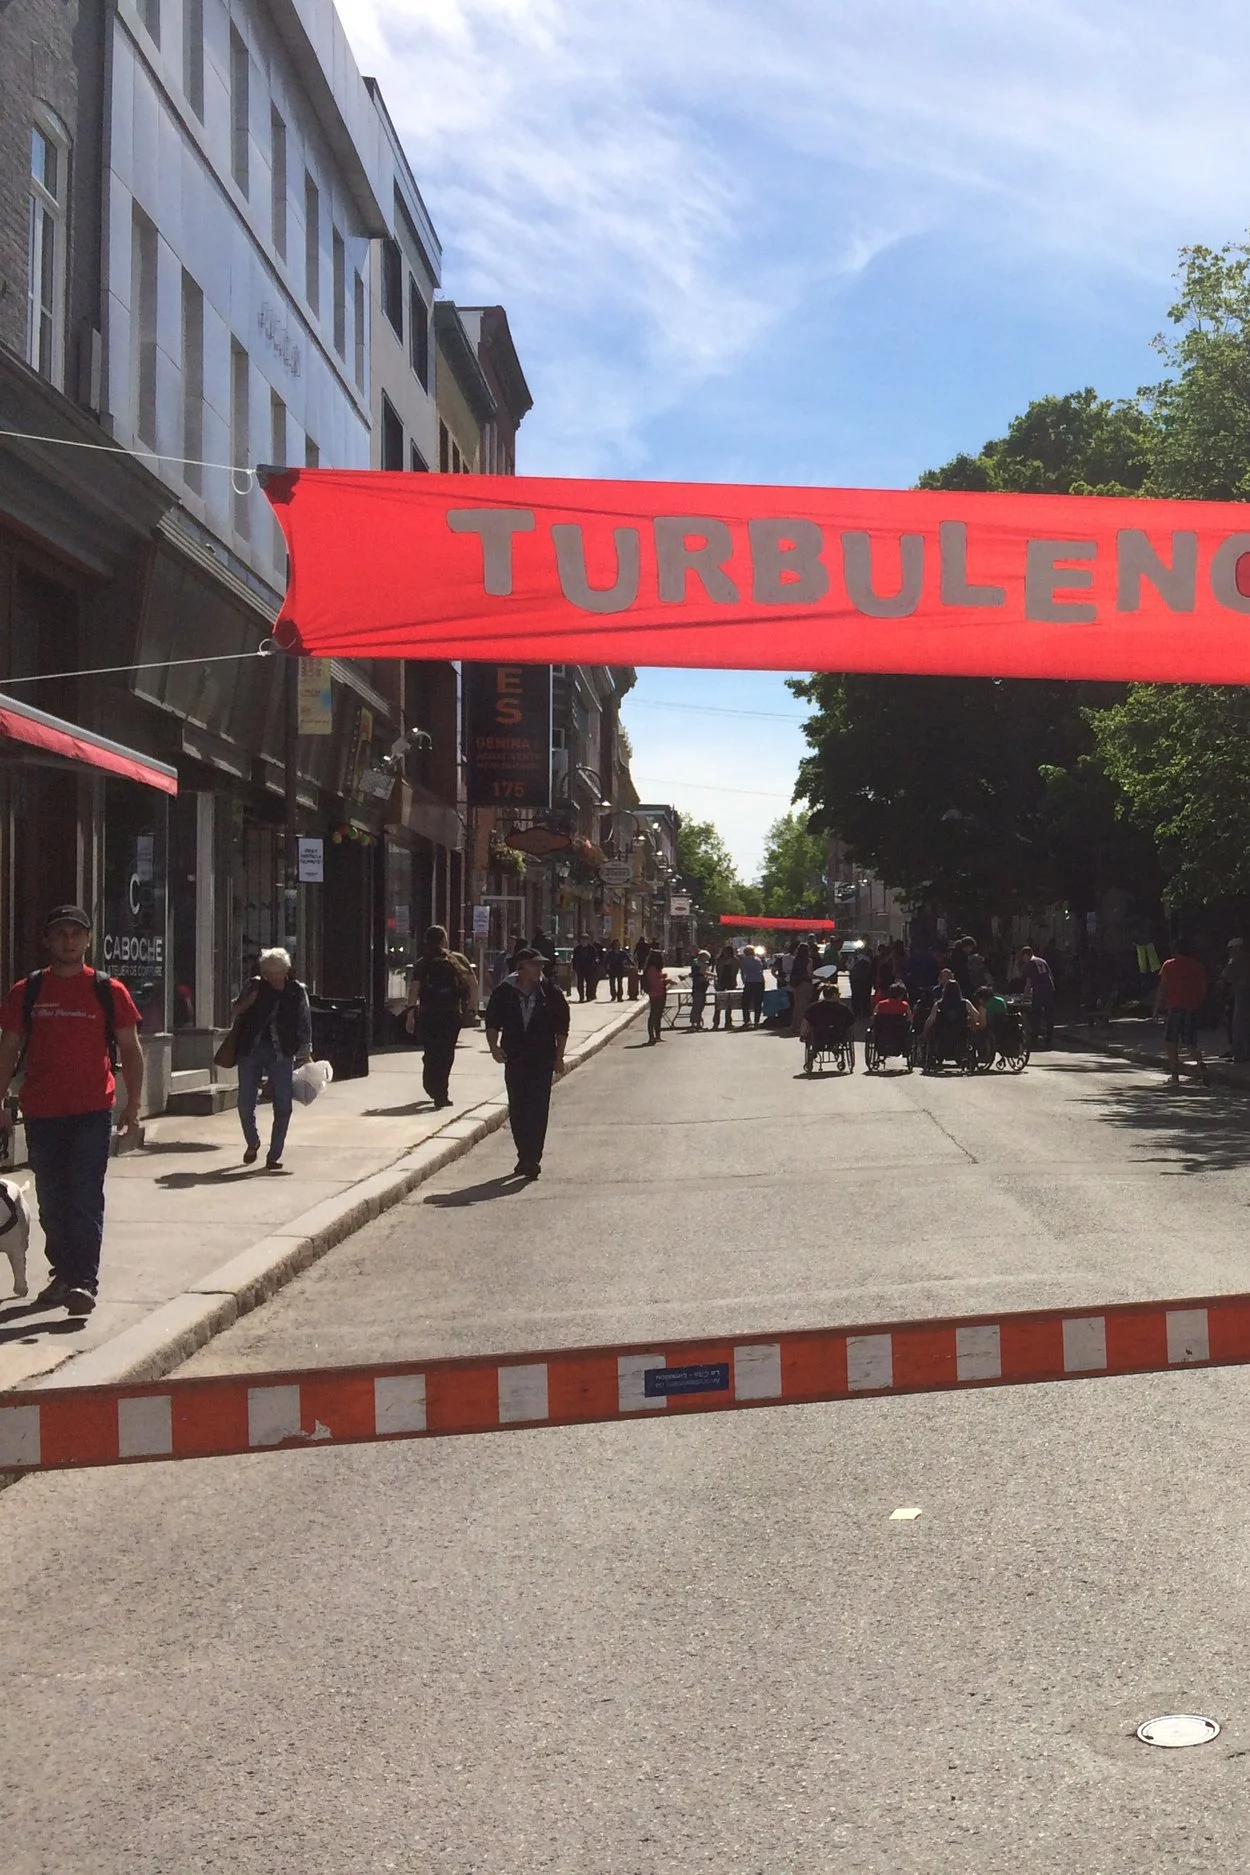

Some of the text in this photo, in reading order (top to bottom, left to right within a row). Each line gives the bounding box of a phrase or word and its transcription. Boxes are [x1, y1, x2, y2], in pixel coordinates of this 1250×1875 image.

[491, 780, 526, 798] 175
[129, 872, 141, 914] C
[104, 934, 163, 961] CABOCHE
